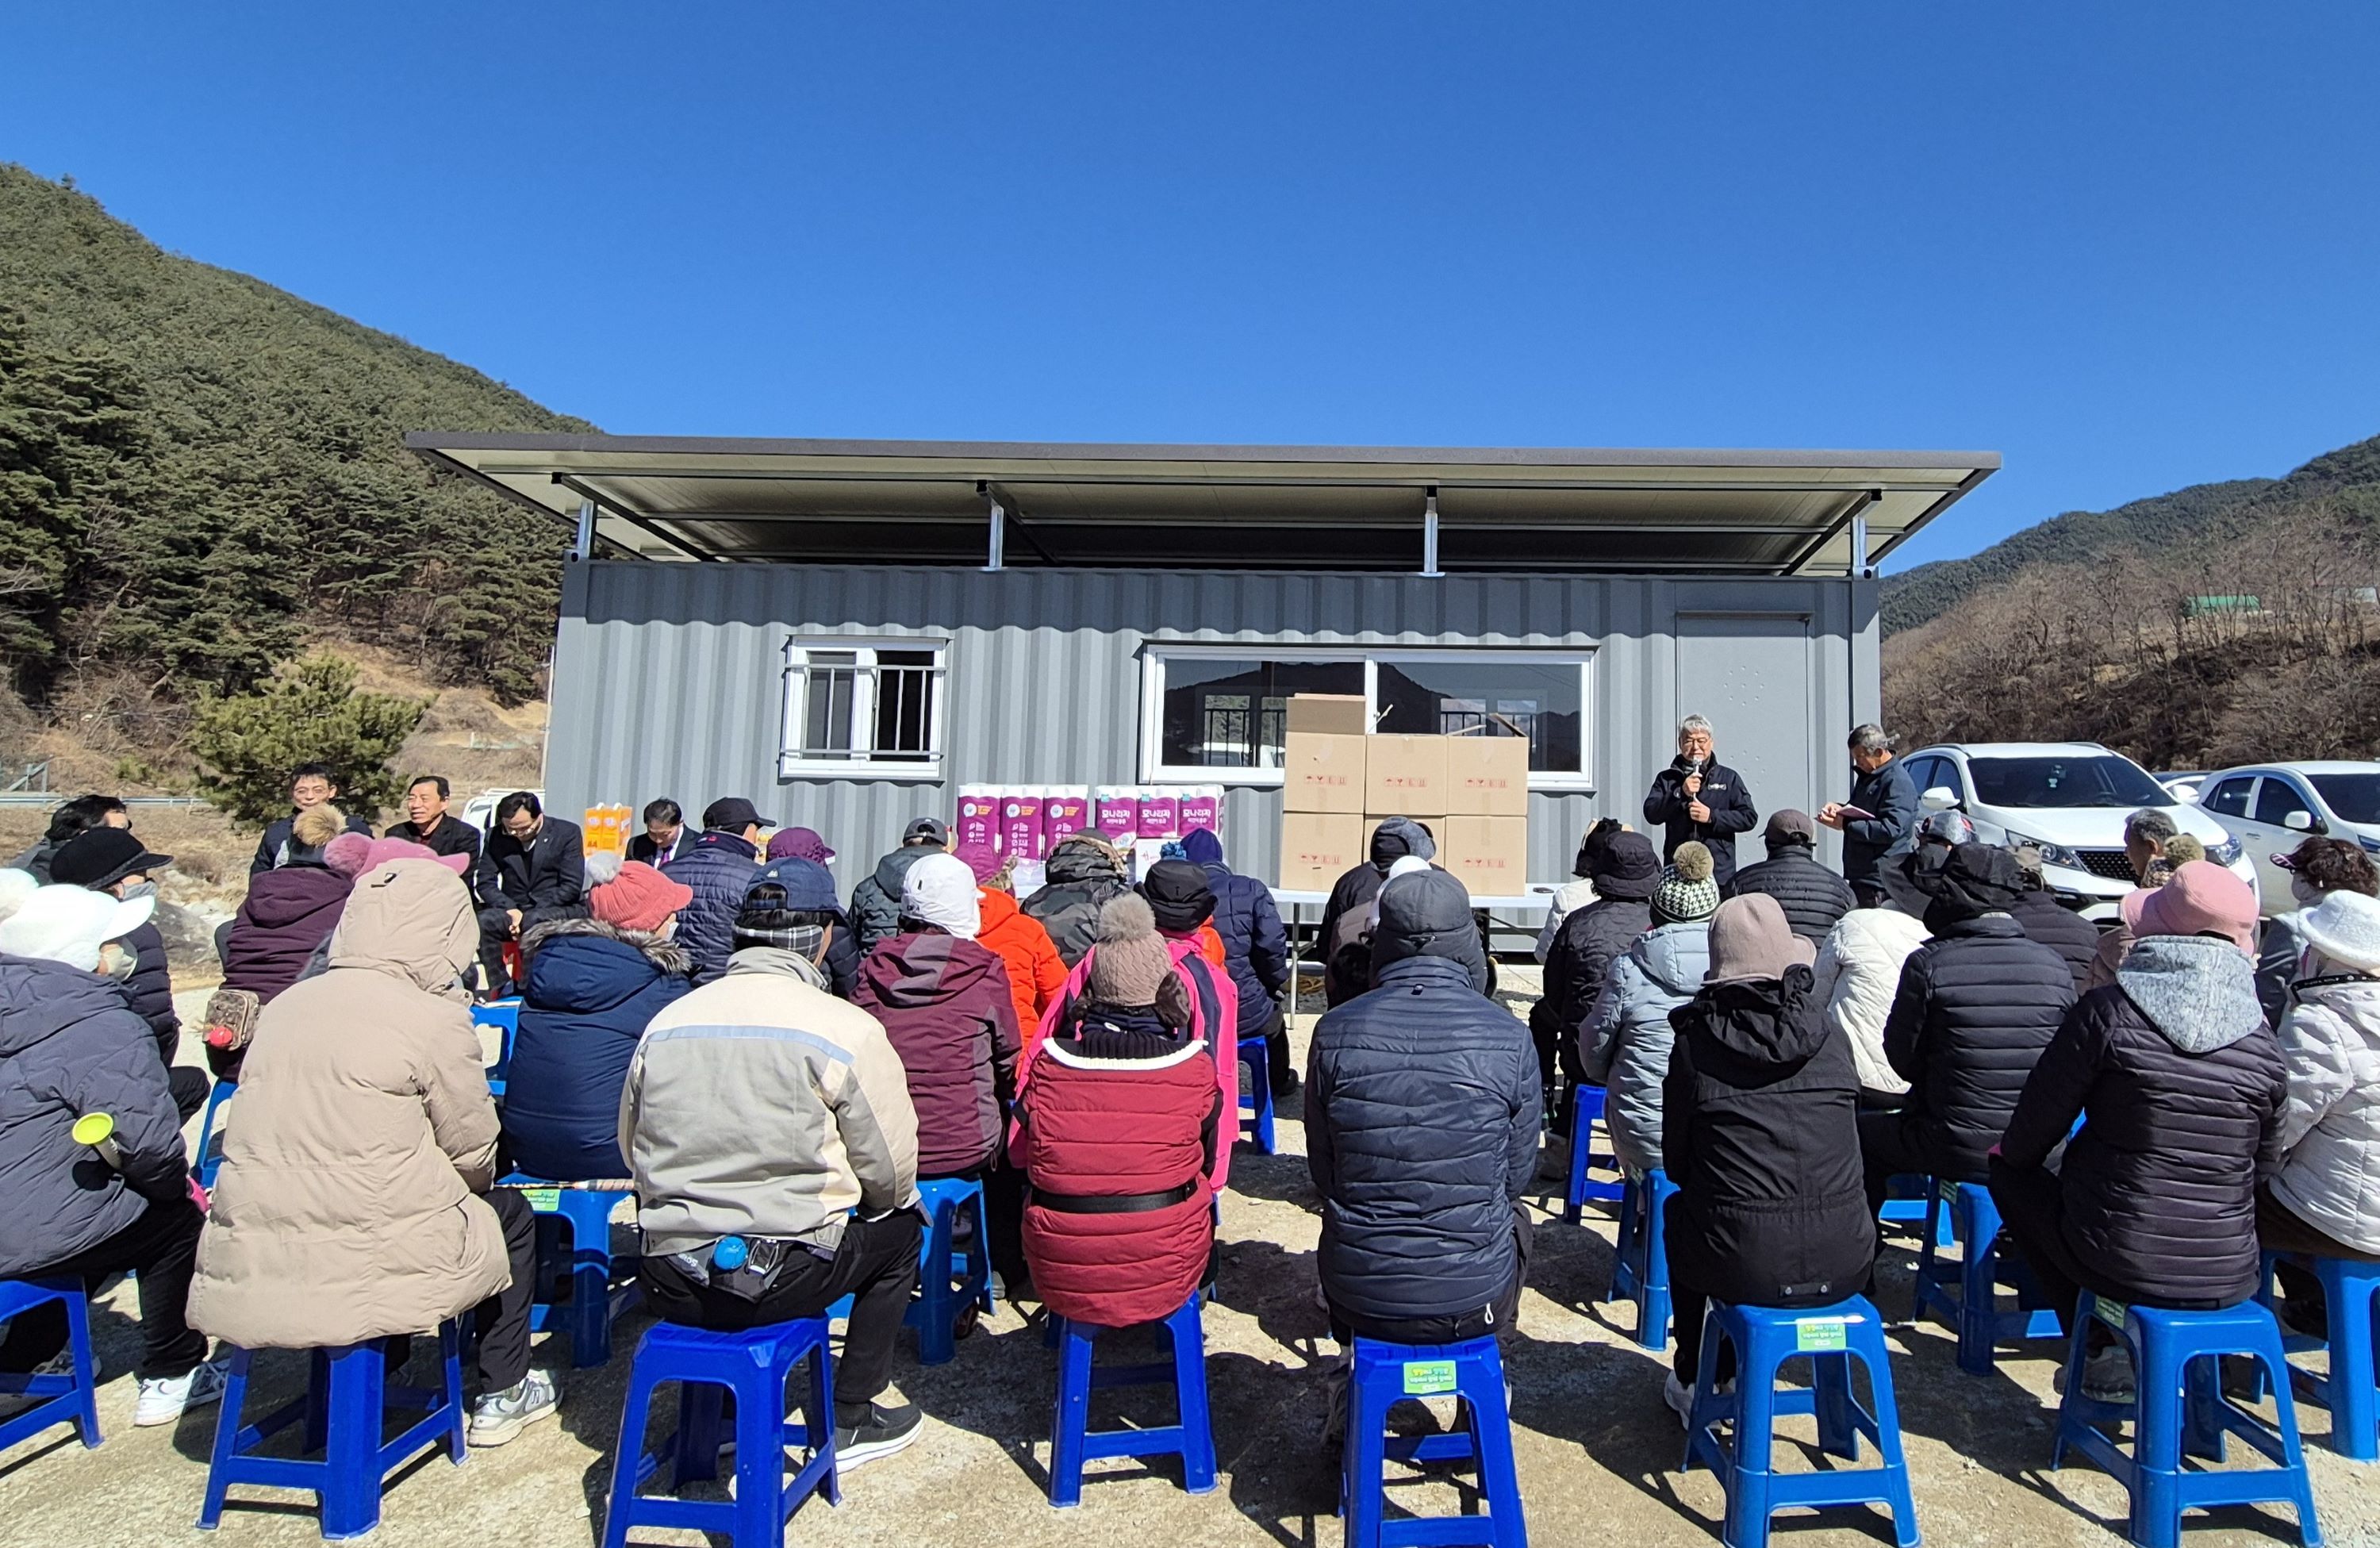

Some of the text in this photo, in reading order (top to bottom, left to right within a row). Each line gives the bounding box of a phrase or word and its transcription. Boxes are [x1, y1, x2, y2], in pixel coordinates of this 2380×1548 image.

[1101, 809, 1130, 819] 모나리자
[1142, 809, 1171, 819] 모나리자
[1183, 809, 1211, 818] 모나리자
